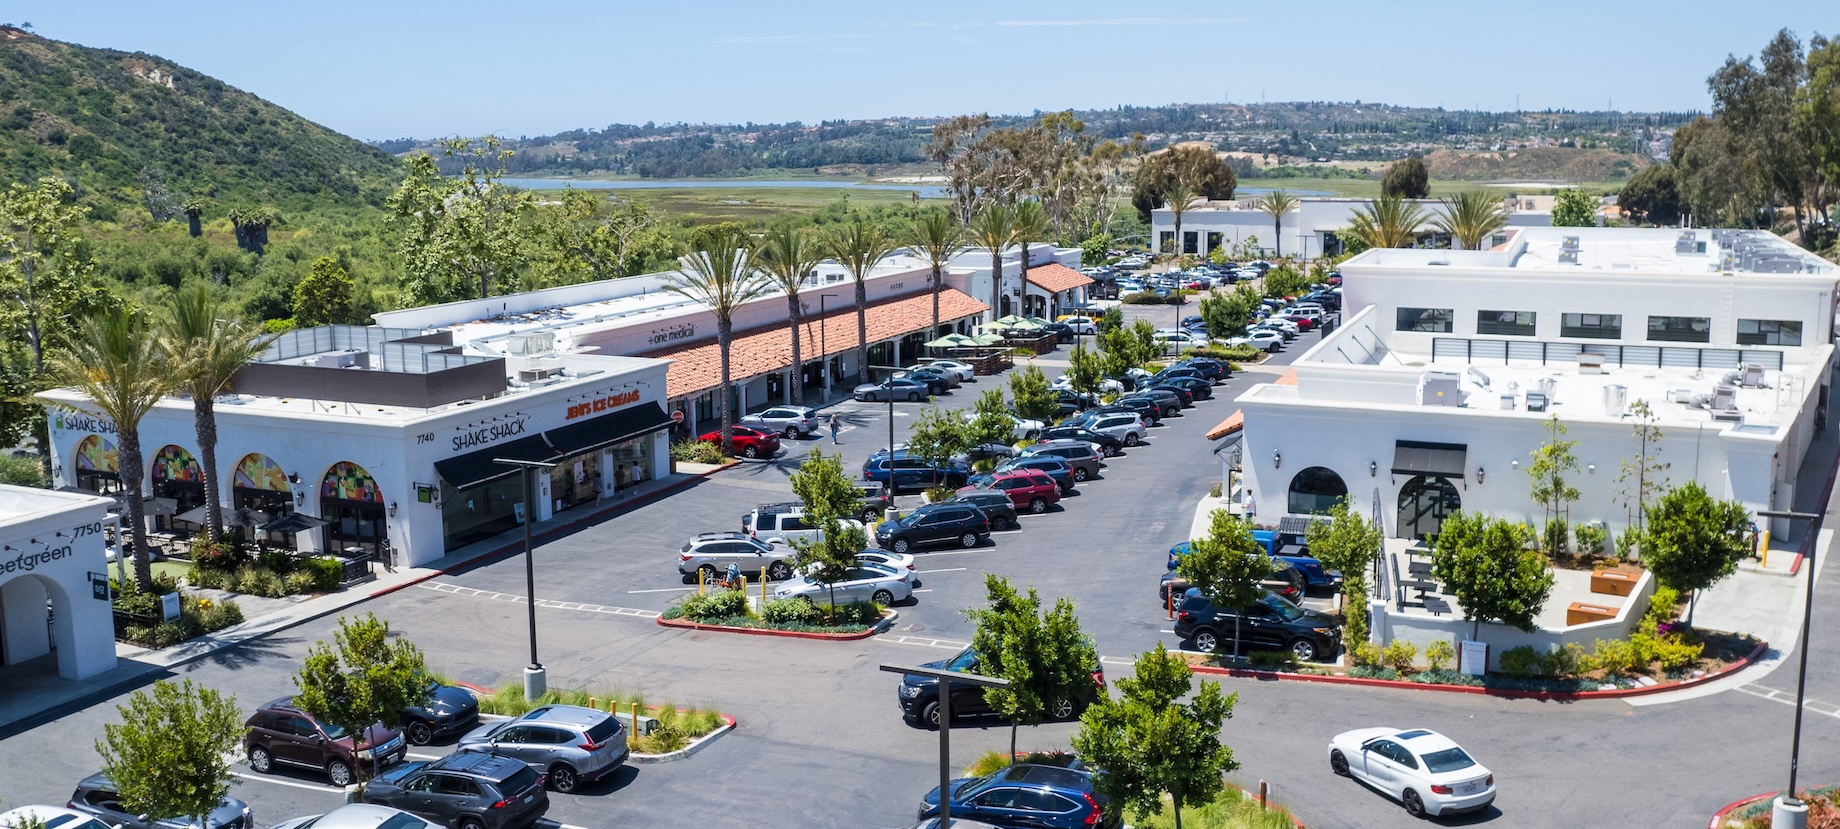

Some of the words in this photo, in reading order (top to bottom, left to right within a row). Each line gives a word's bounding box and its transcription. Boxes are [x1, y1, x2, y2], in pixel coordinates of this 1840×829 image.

[654, 333, 668, 344] one
[668, 325, 694, 341] medical
[566, 402, 592, 420] JENI'S
[593, 398, 607, 413] ICE
[607, 389, 640, 408] CREAMS
[65, 417, 97, 433] SHAKE
[98, 420, 118, 434] SHA
[416, 432, 435, 445] 7740
[452, 428, 489, 451] SHAKE
[489, 419, 525, 441] SHACK
[73, 522, 102, 539] 7750
[94, 584, 105, 595] sg
